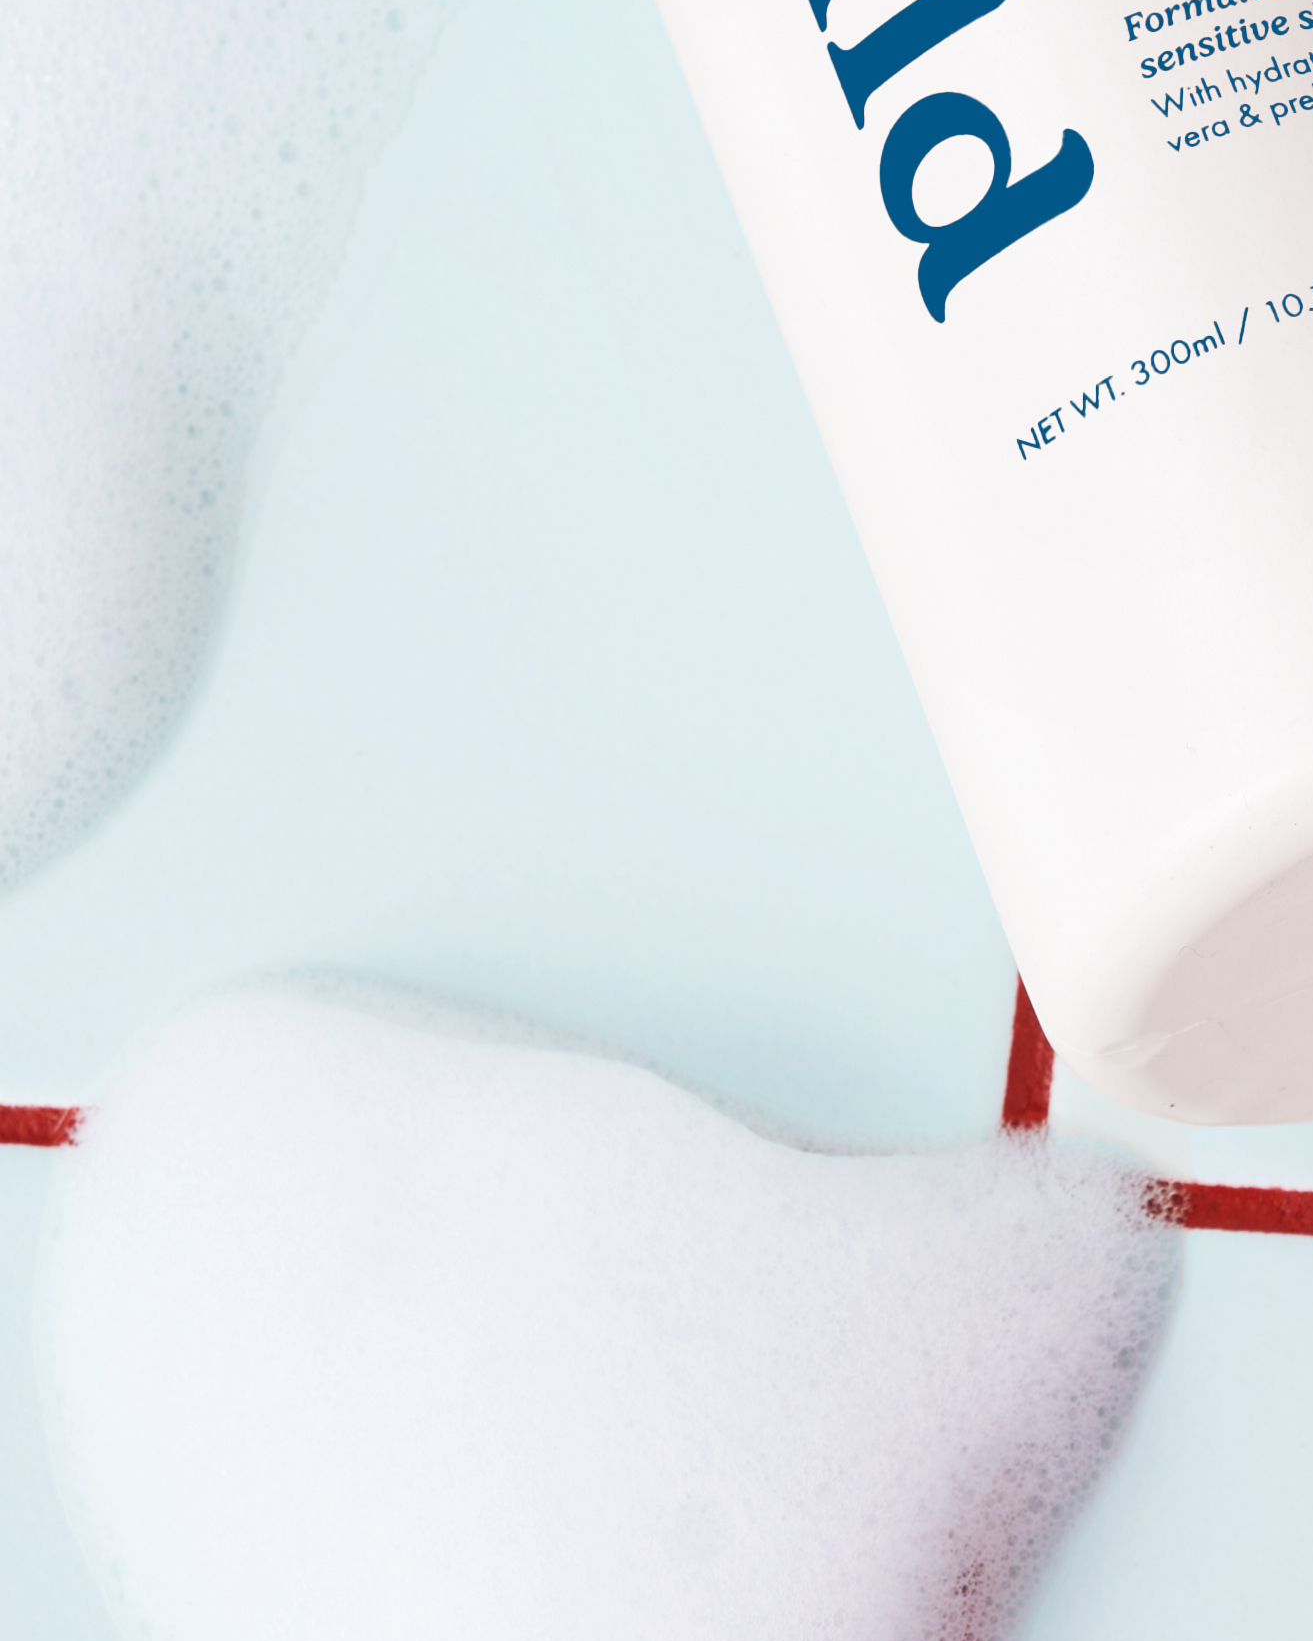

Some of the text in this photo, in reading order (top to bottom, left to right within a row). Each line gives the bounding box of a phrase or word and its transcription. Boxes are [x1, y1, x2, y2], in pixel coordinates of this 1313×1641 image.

[1141, 19, 1289, 79] sensitive
[1151, 78, 1221, 117] With
[1167, 120, 1230, 151] vera
[1239, 104, 1262, 127] &
[1017, 408, 1065, 460] NET
[1070, 376, 1125, 417] WT.
[1131, 321, 1225, 385] 300ml
[1239, 307, 1249, 344] /
